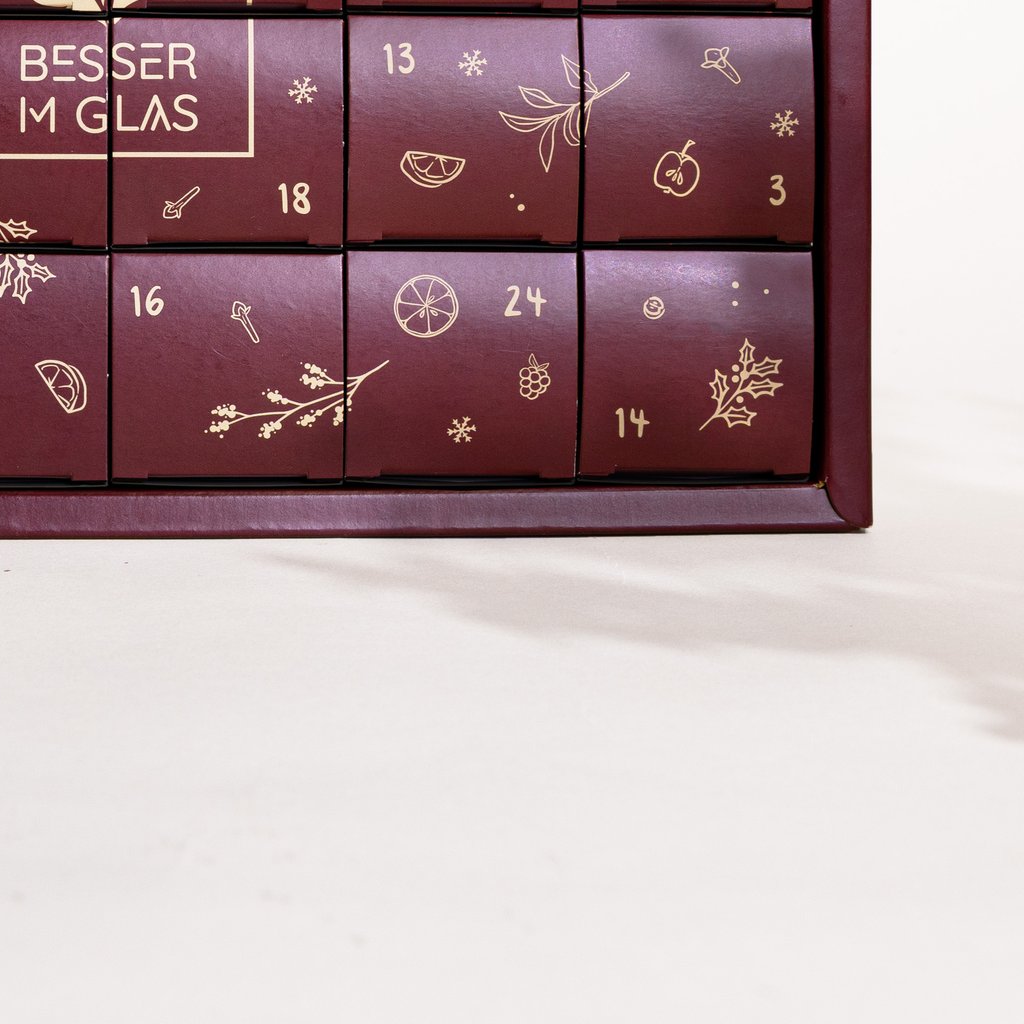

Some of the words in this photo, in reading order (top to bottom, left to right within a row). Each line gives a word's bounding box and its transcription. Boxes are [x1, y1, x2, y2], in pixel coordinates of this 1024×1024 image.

[20, 42, 197, 82] BESSER
[382, 41, 416, 75] 13
[76, 93, 199, 134] GLAS
[278, 182, 311, 215] 18
[769, 174, 786, 206] 3
[130, 285, 165, 317] 16
[503, 284, 548, 318] 24
[615, 407, 650, 438] 14
